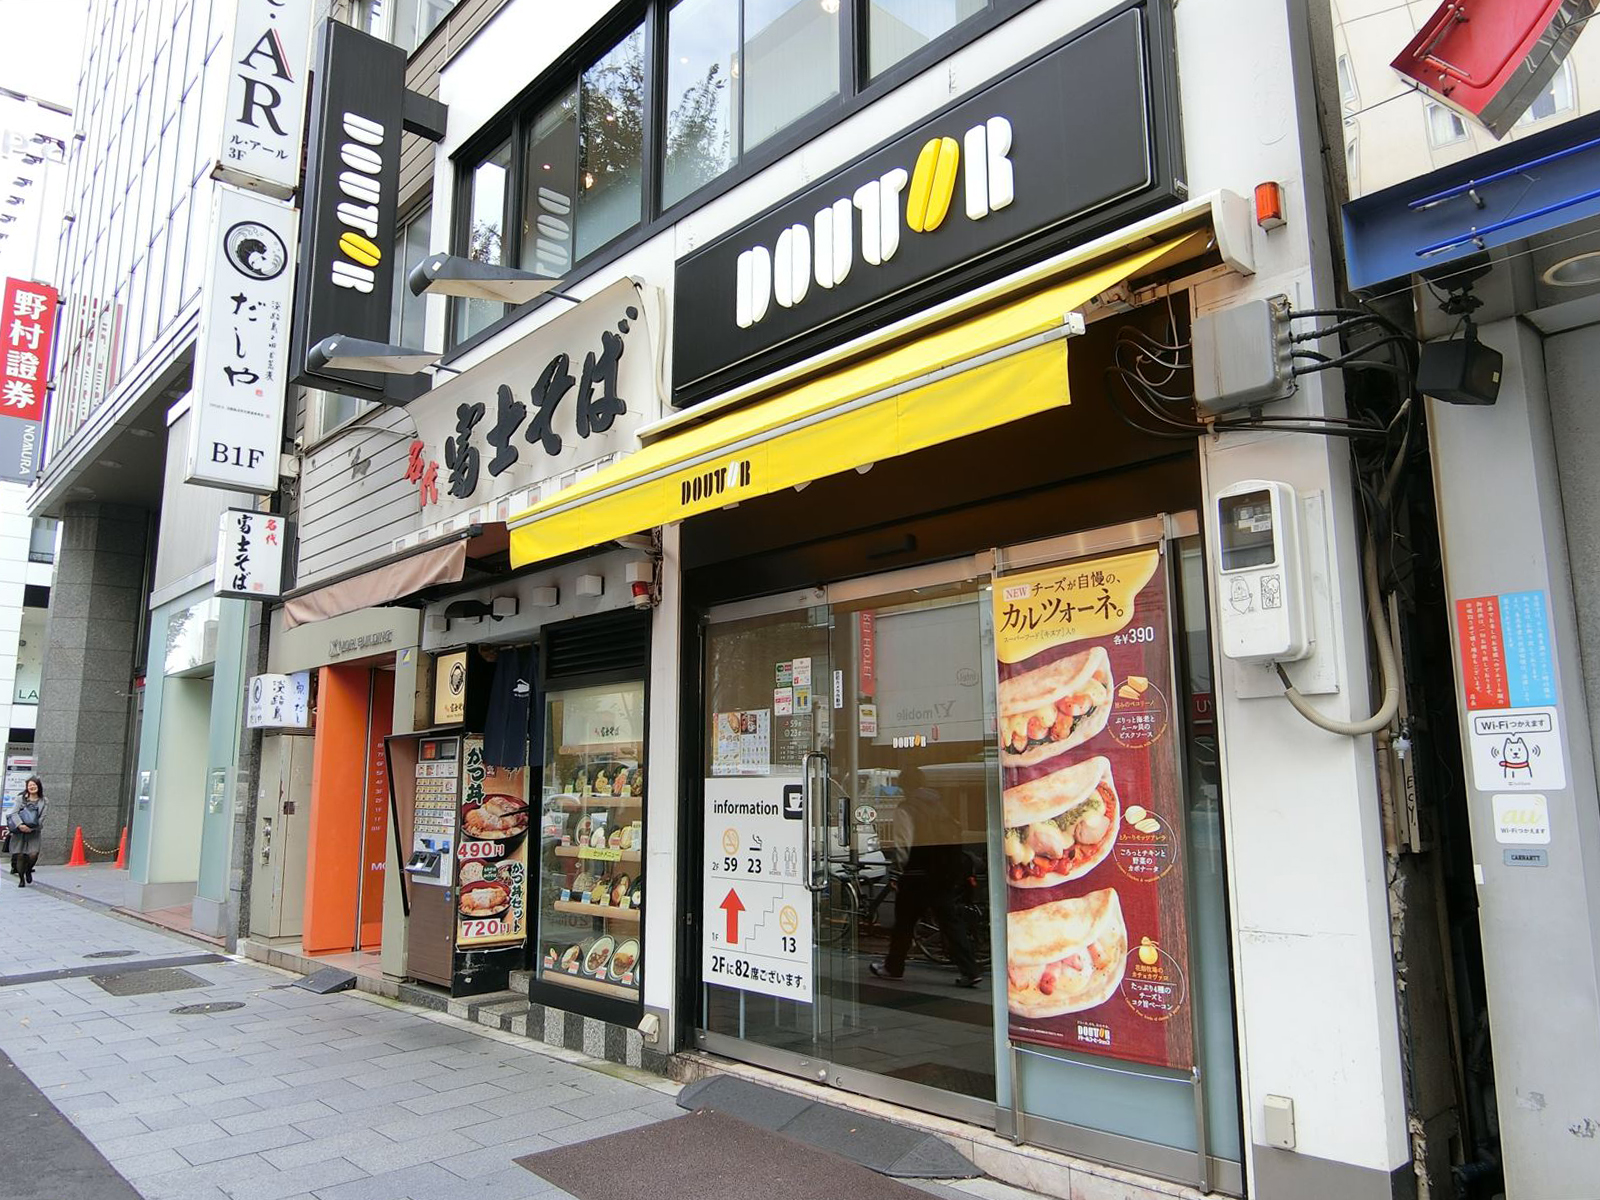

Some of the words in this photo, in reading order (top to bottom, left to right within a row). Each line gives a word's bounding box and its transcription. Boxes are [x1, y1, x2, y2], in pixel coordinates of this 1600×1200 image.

[228, 147, 247, 160] 3F
[230, 135, 289, 160] ル・アール
[332, 112, 385, 293] DOUTOR
[736, 116, 1014, 329] DOUTOR
[2, 289, 48, 410] 野村證券
[223, 292, 266, 387] だしや
[403, 440, 440, 507] 名代
[444, 305, 639, 499] 富士そば
[18, 424, 36, 476] NOMURA
[210, 441, 265, 469] B1F
[681, 460, 751, 506] DOUTOR
[265, 519, 278, 546] 名代
[232, 513, 254, 591] 富士そば
[1005, 586, 1028, 599] NEW
[1031, 570, 1121, 597] チーズが自慢の、
[1000, 588, 1124, 634] カルツォーネ。
[1113, 625, 1155, 646] 各¥390
[1121, 723, 1151, 732] ムール貝の
[1481, 719, 1545, 731] Wi-Fiつかえます
[892, 734, 927, 749] DOUTOR
[466, 747, 486, 805] かつ丼
[713, 799, 779, 815] information
[1501, 808, 1543, 825] au
[1500, 827, 1546, 835] Wi-Fiつかえます
[457, 841, 505, 858] 490円
[712, 861, 719, 871] 2F
[723, 857, 738, 872] 59
[747, 858, 762, 874] 23
[1128, 864, 1159, 873] カポナータ
[1132, 856, 1153, 865] 野菜の
[511, 862, 524, 934] かつ丼セット
[462, 919, 510, 937] 720円
[711, 932, 719, 942] 1F
[781, 936, 796, 953] 13
[711, 955, 807, 990] 2Fに82席ございます。
[1138, 992, 1163, 1002] チーズと
[1077, 1025, 1111, 1040] DOUTOR
